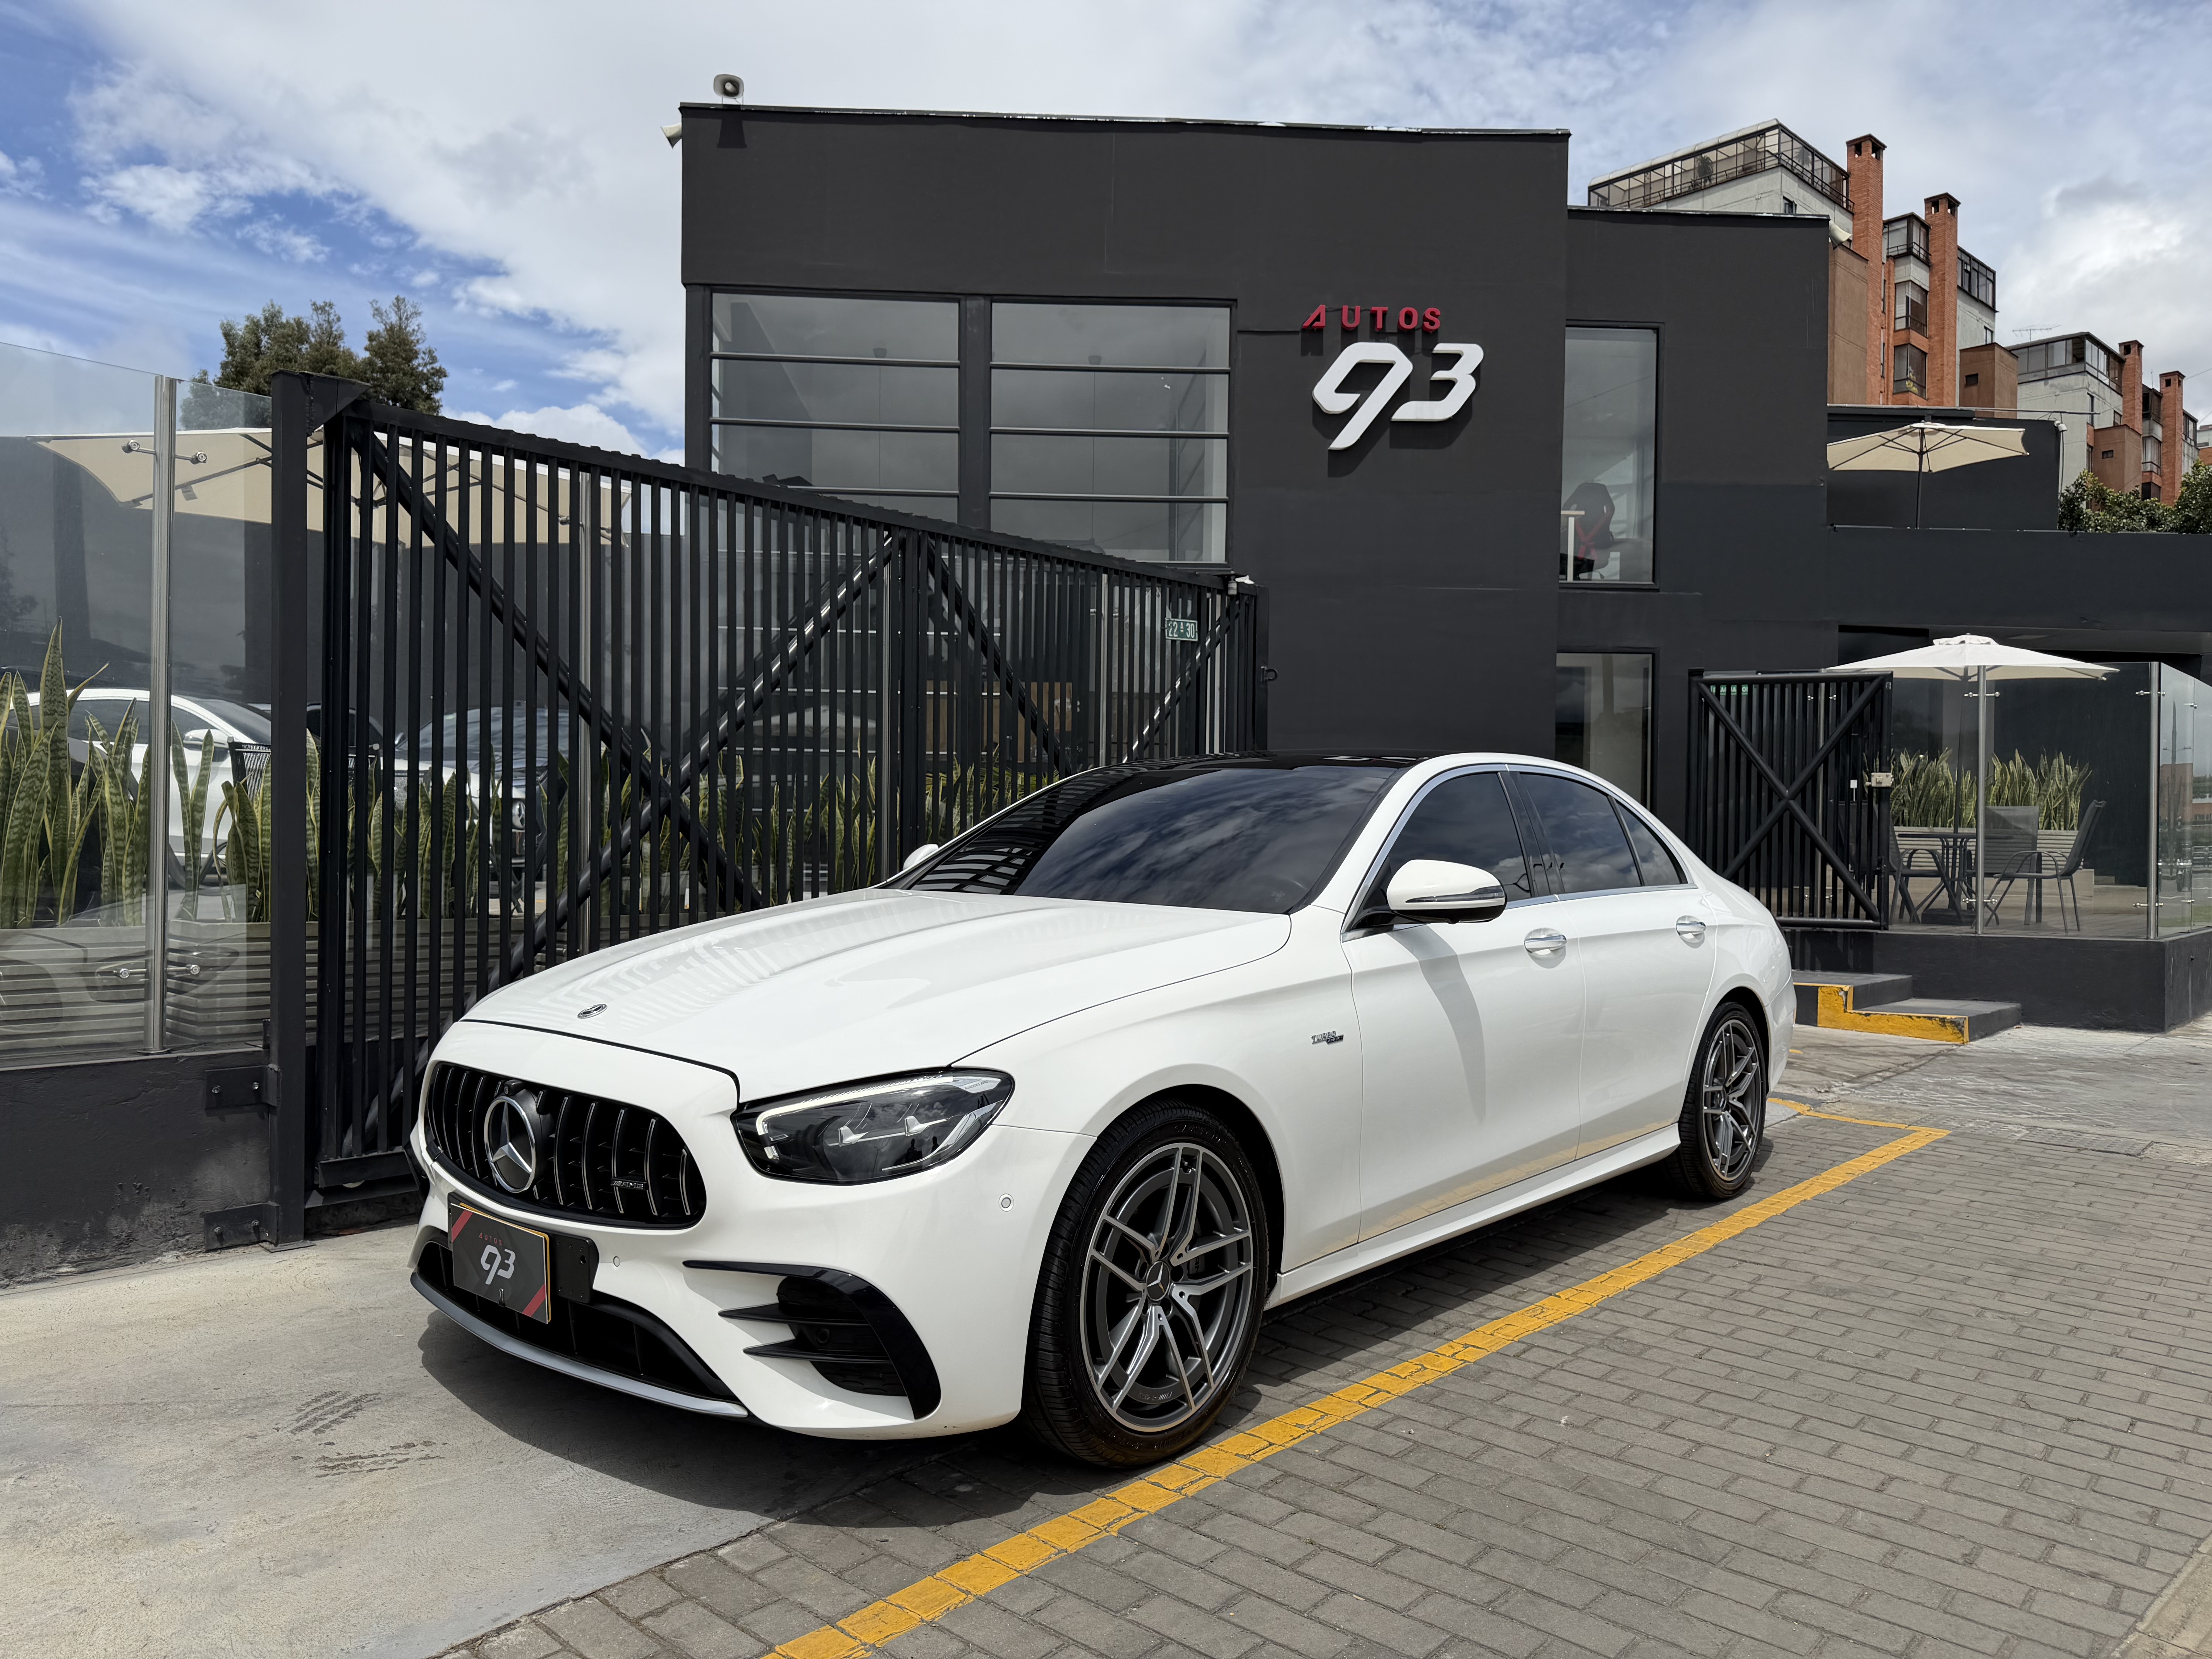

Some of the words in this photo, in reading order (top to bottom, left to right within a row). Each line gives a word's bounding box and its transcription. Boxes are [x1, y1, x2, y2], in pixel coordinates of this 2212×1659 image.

[1302, 304, 1441, 332] AUTOS
[1312, 342, 1484, 450] 93
[1168, 621, 1178, 637] 22
[1186, 623, 1194, 638] 30
[479, 1233, 502, 1246] AUTOS
[481, 1245, 516, 1285] 93
